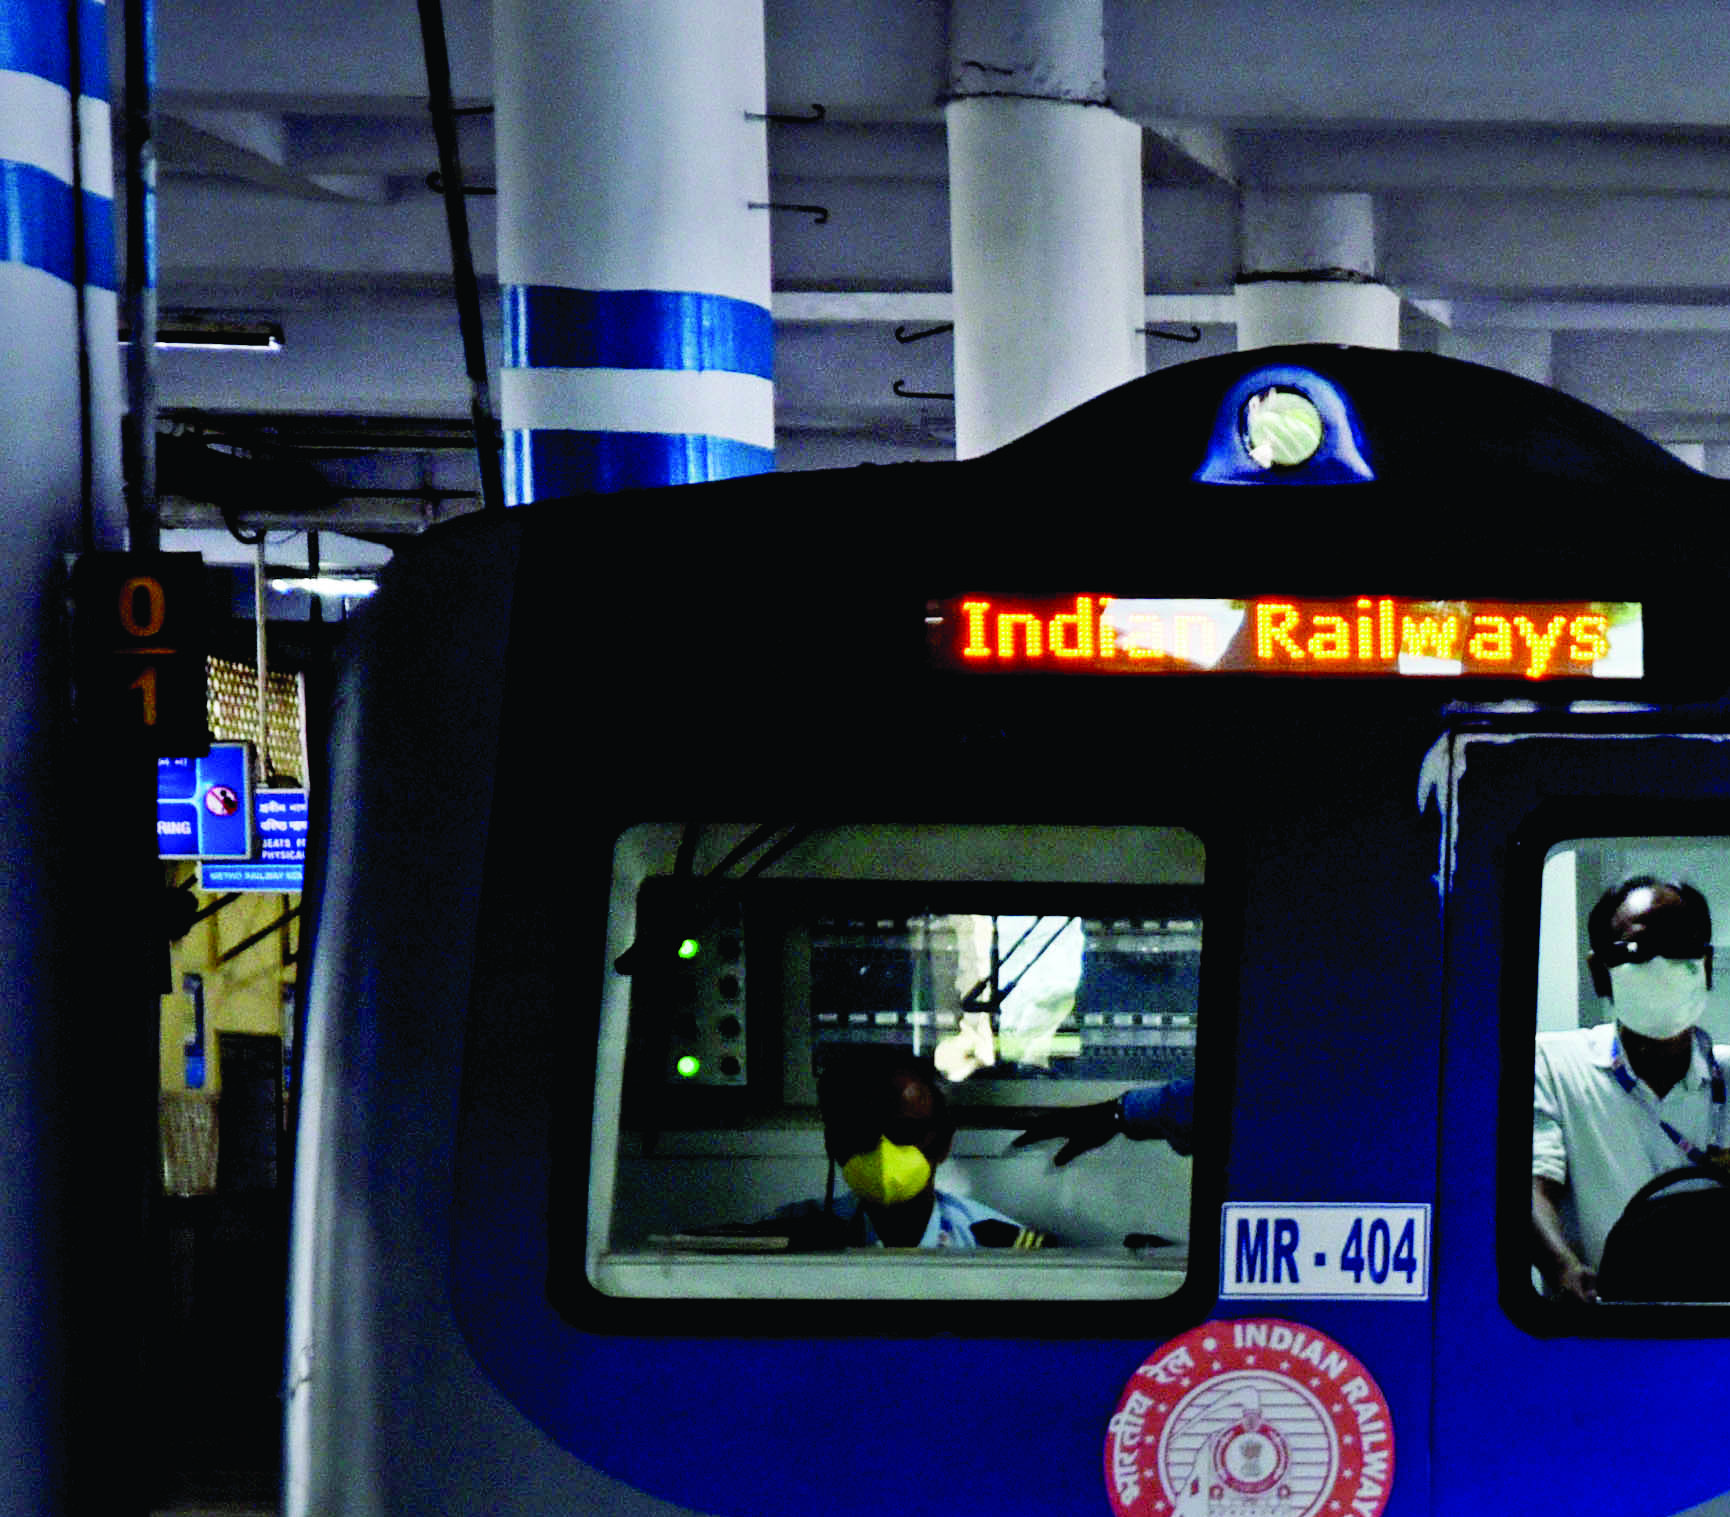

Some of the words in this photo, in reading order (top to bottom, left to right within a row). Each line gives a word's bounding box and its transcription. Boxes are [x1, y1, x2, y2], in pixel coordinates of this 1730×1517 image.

[118, 576, 167, 637] 0
[1256, 597, 1610, 680] Railways
[128, 667, 158, 726] 1
[1234, 1218, 1300, 1285] MR
[1341, 1217, 1418, 1284] 404
[1233, 1323, 1348, 1380] INDIAN
[1108, 1389, 1155, 1507] भारतीय
[1138, 1346, 1195, 1383] रेल
